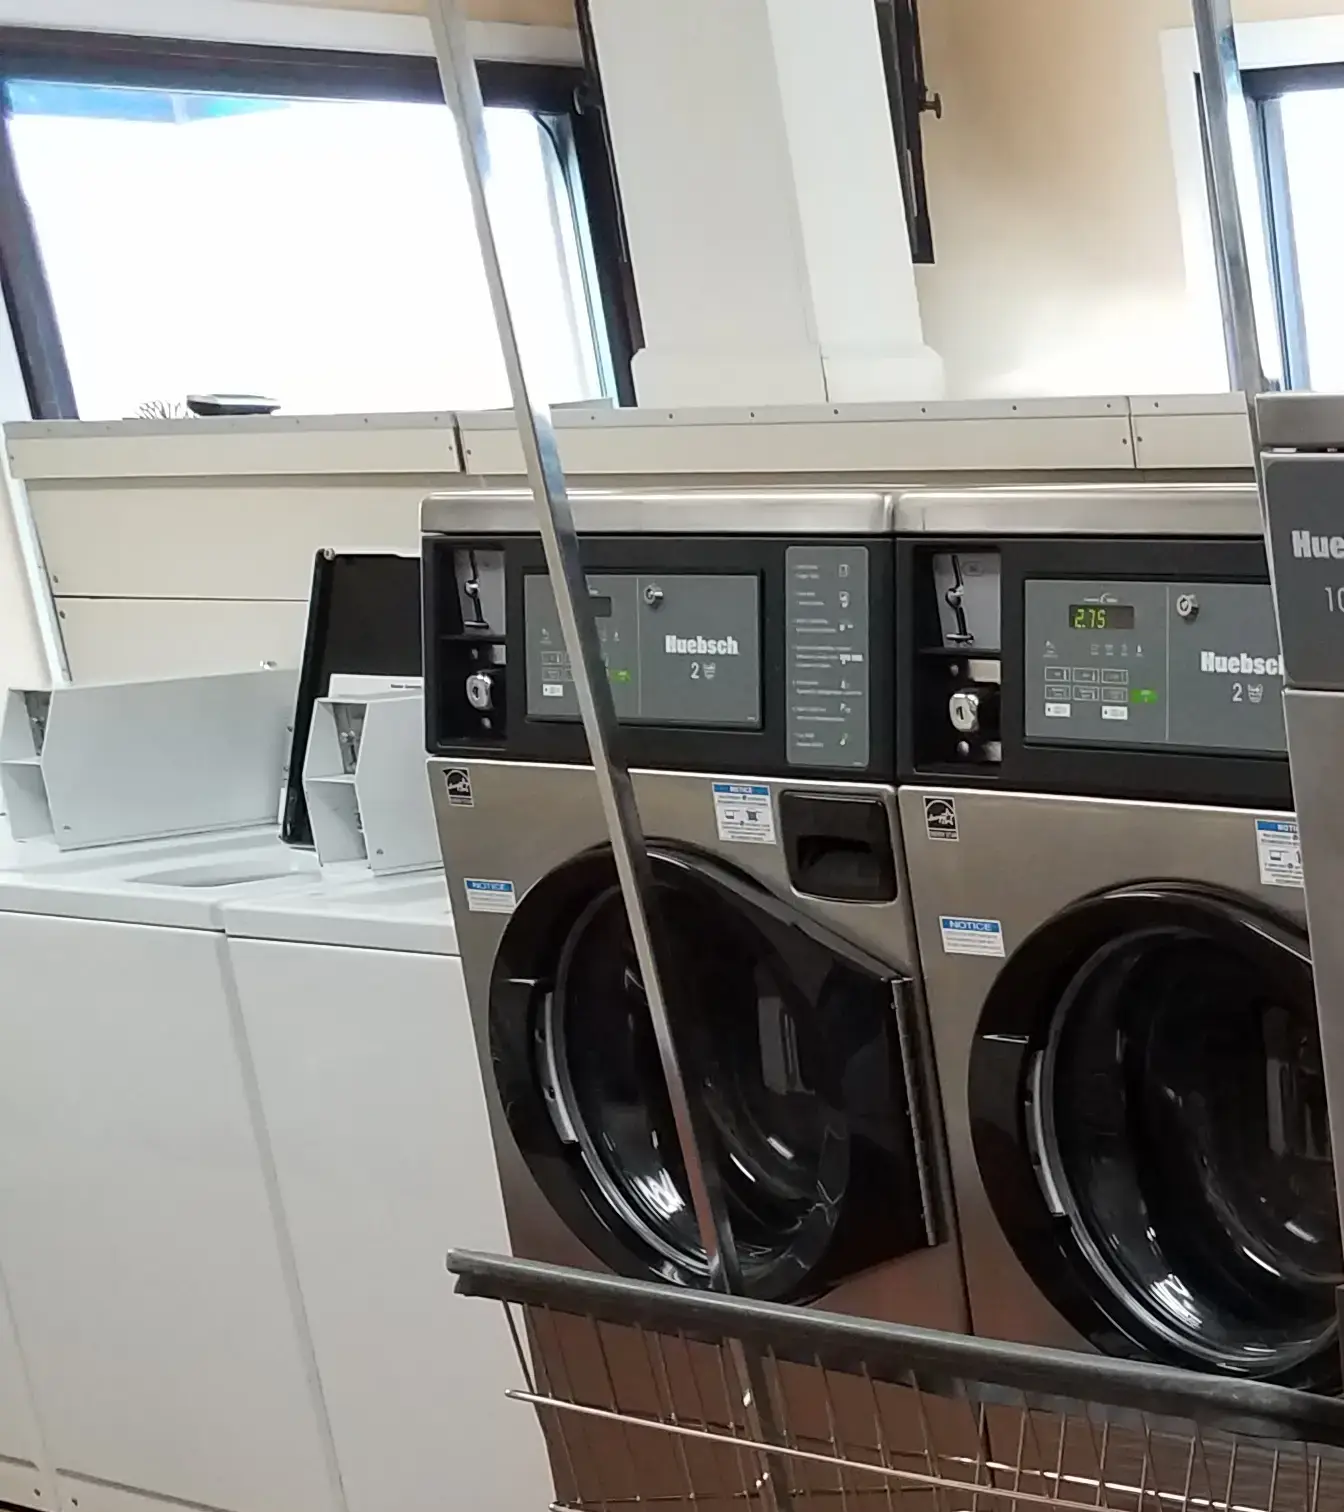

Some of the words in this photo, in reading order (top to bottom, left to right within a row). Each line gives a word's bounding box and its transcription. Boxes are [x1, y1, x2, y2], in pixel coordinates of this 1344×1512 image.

[665, 634, 740, 655] Huebsch
[690, 661, 700, 679] 2
[1232, 682, 1243, 702] 2
[949, 919, 993, 931] NOTICE
